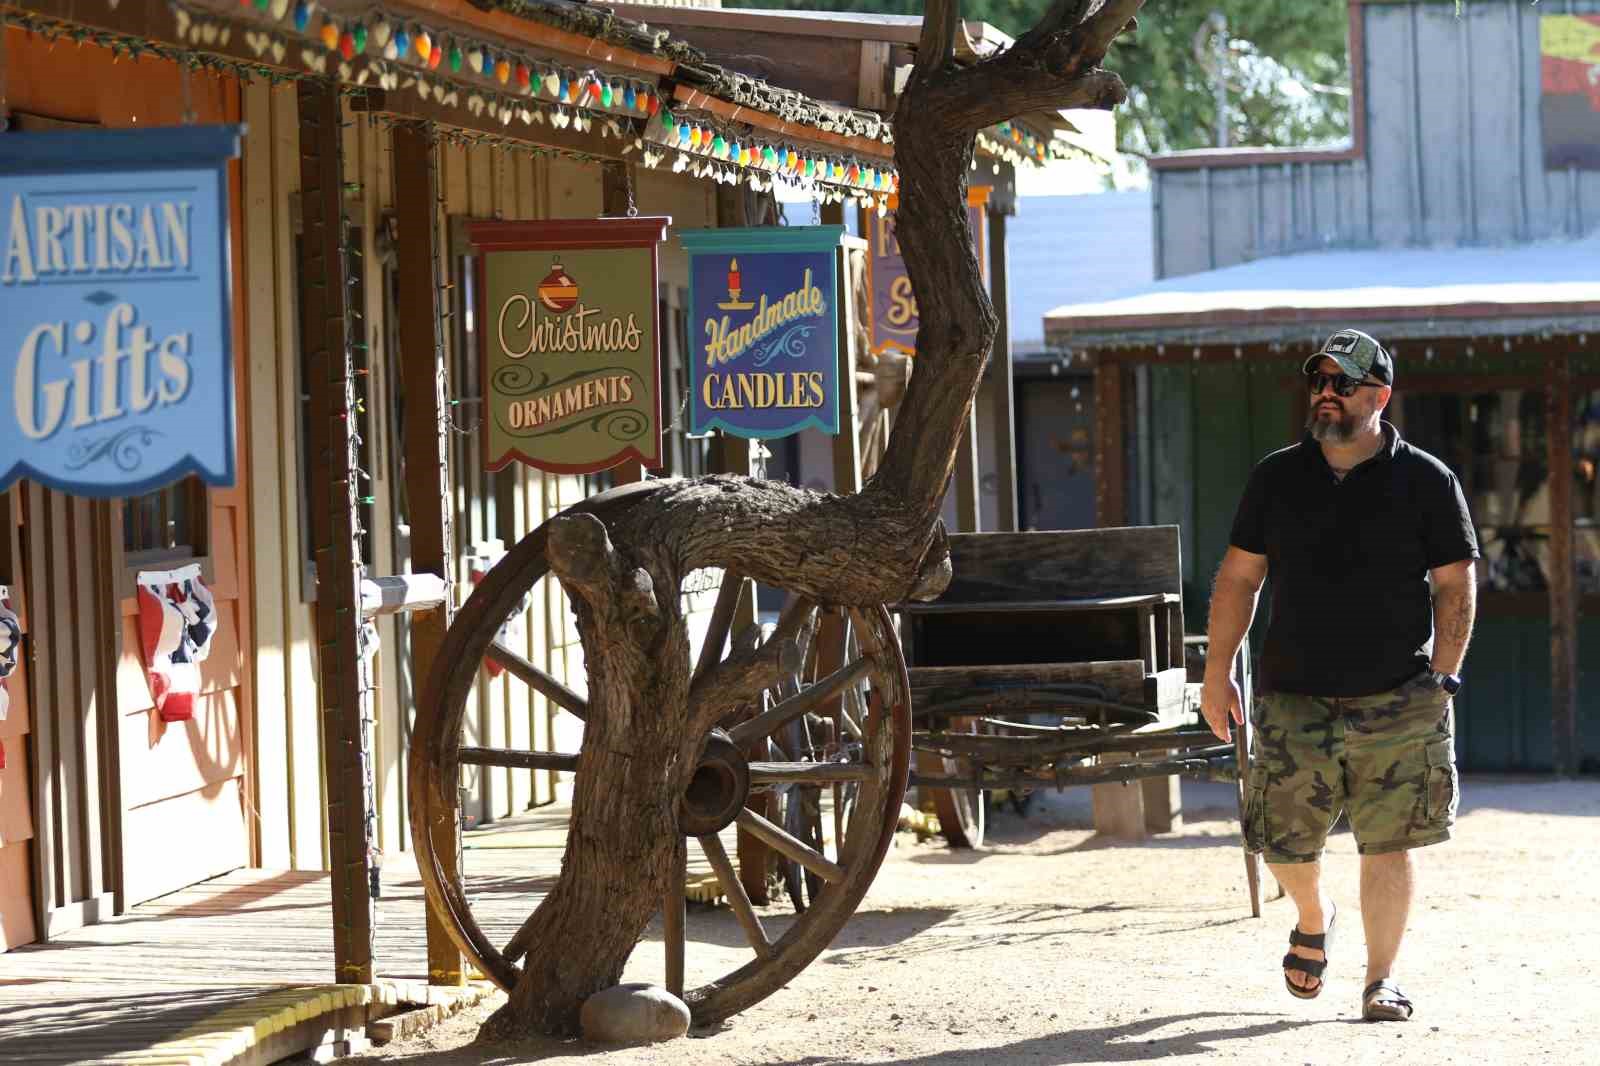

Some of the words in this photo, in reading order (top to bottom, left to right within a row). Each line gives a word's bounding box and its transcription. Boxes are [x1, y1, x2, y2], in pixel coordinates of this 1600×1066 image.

[1, 192, 191, 284] ARTISAN
[498, 294, 642, 359] Christmas
[704, 268, 826, 367] Handmade
[14, 302, 191, 441] Gifts
[508, 375, 633, 428] ORNAMENTS
[702, 372, 824, 410] CANDLES
